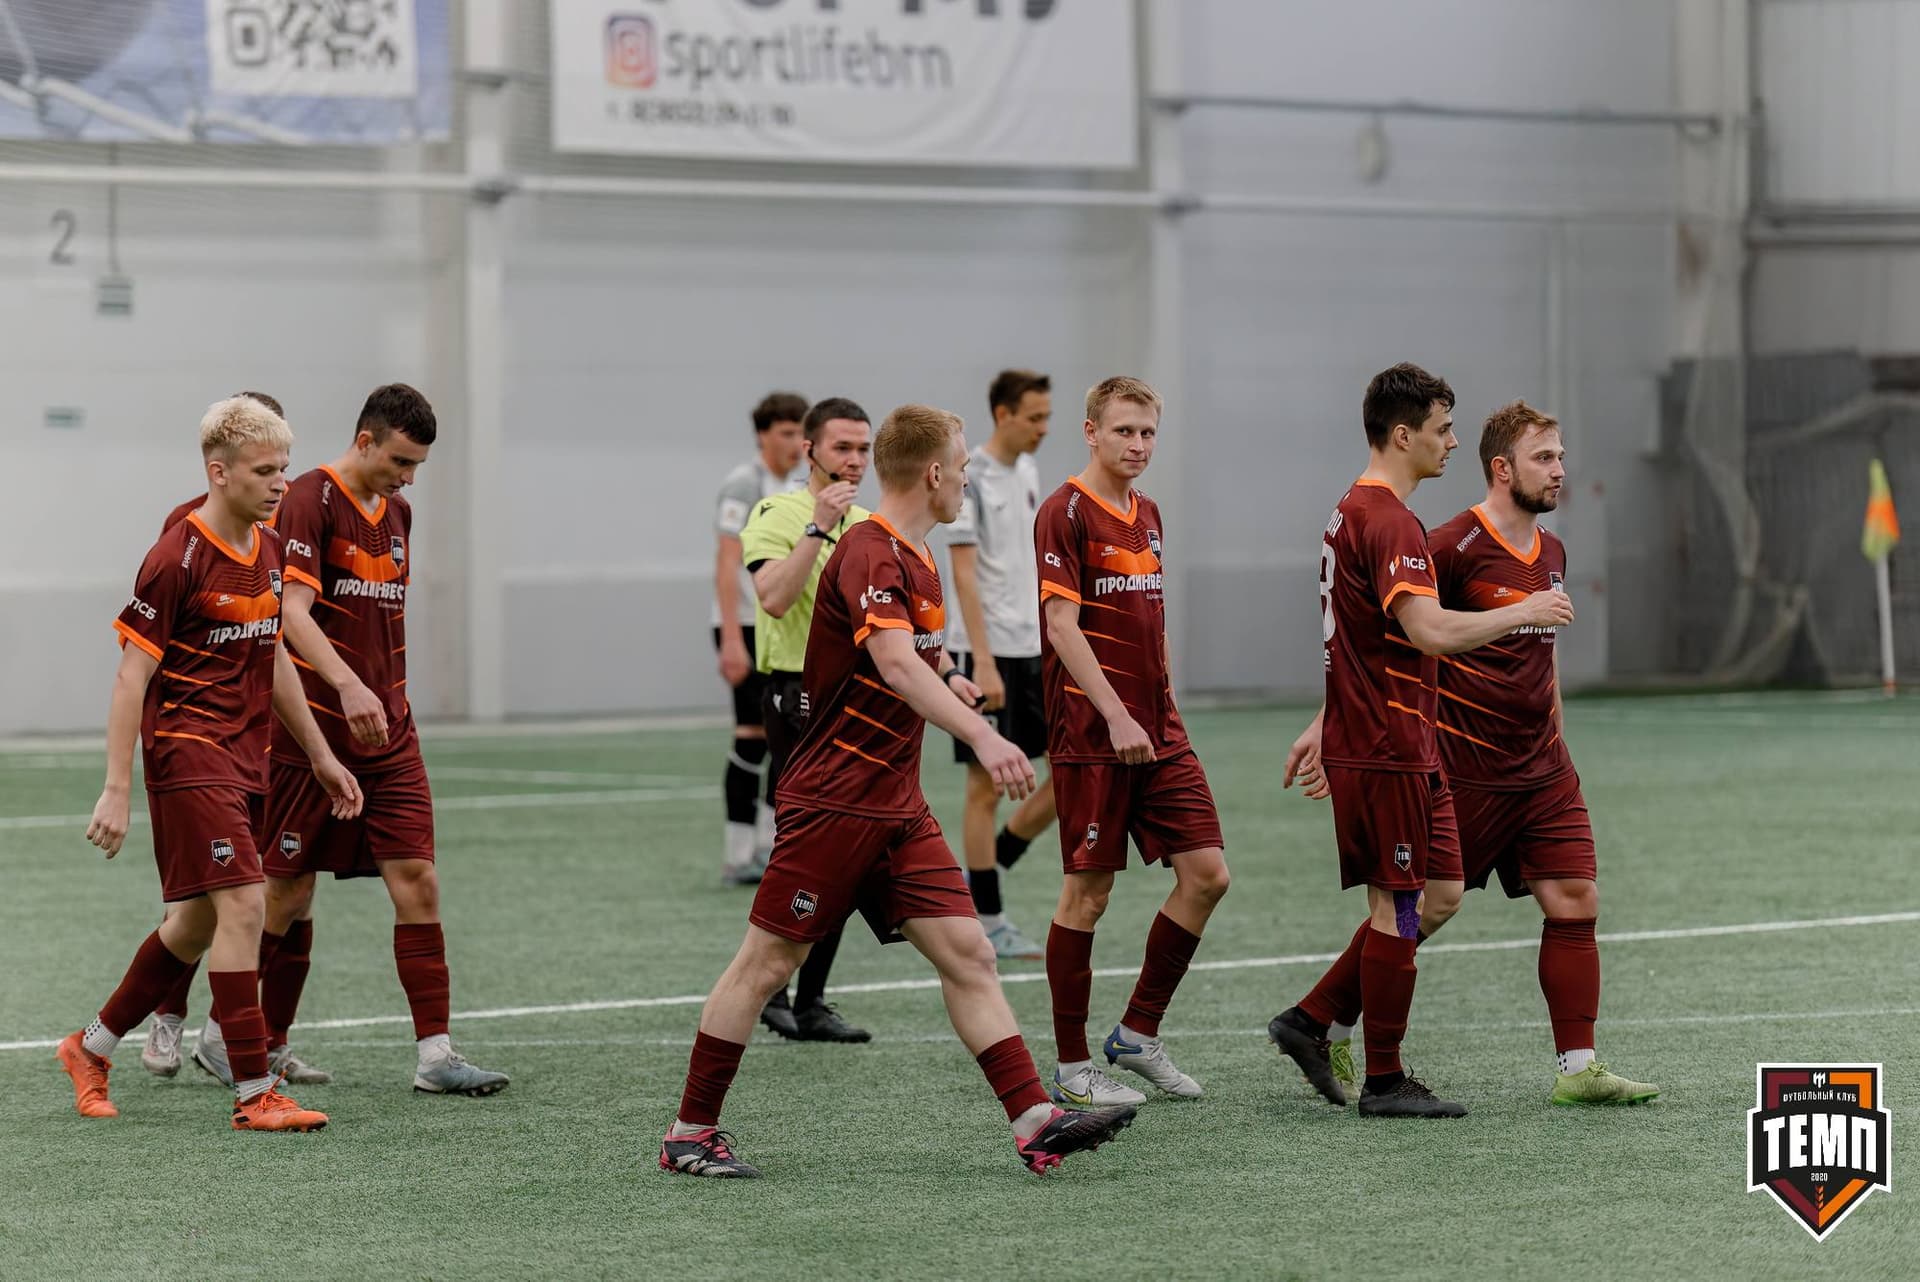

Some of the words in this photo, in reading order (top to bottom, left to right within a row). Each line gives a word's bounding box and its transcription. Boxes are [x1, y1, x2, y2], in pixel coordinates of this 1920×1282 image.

[50, 207, 77, 265] 2
[1045, 552, 1061, 568] СБ
[1402, 554, 1427, 571] ПСБ
[128, 595, 157, 620] ПСБ
